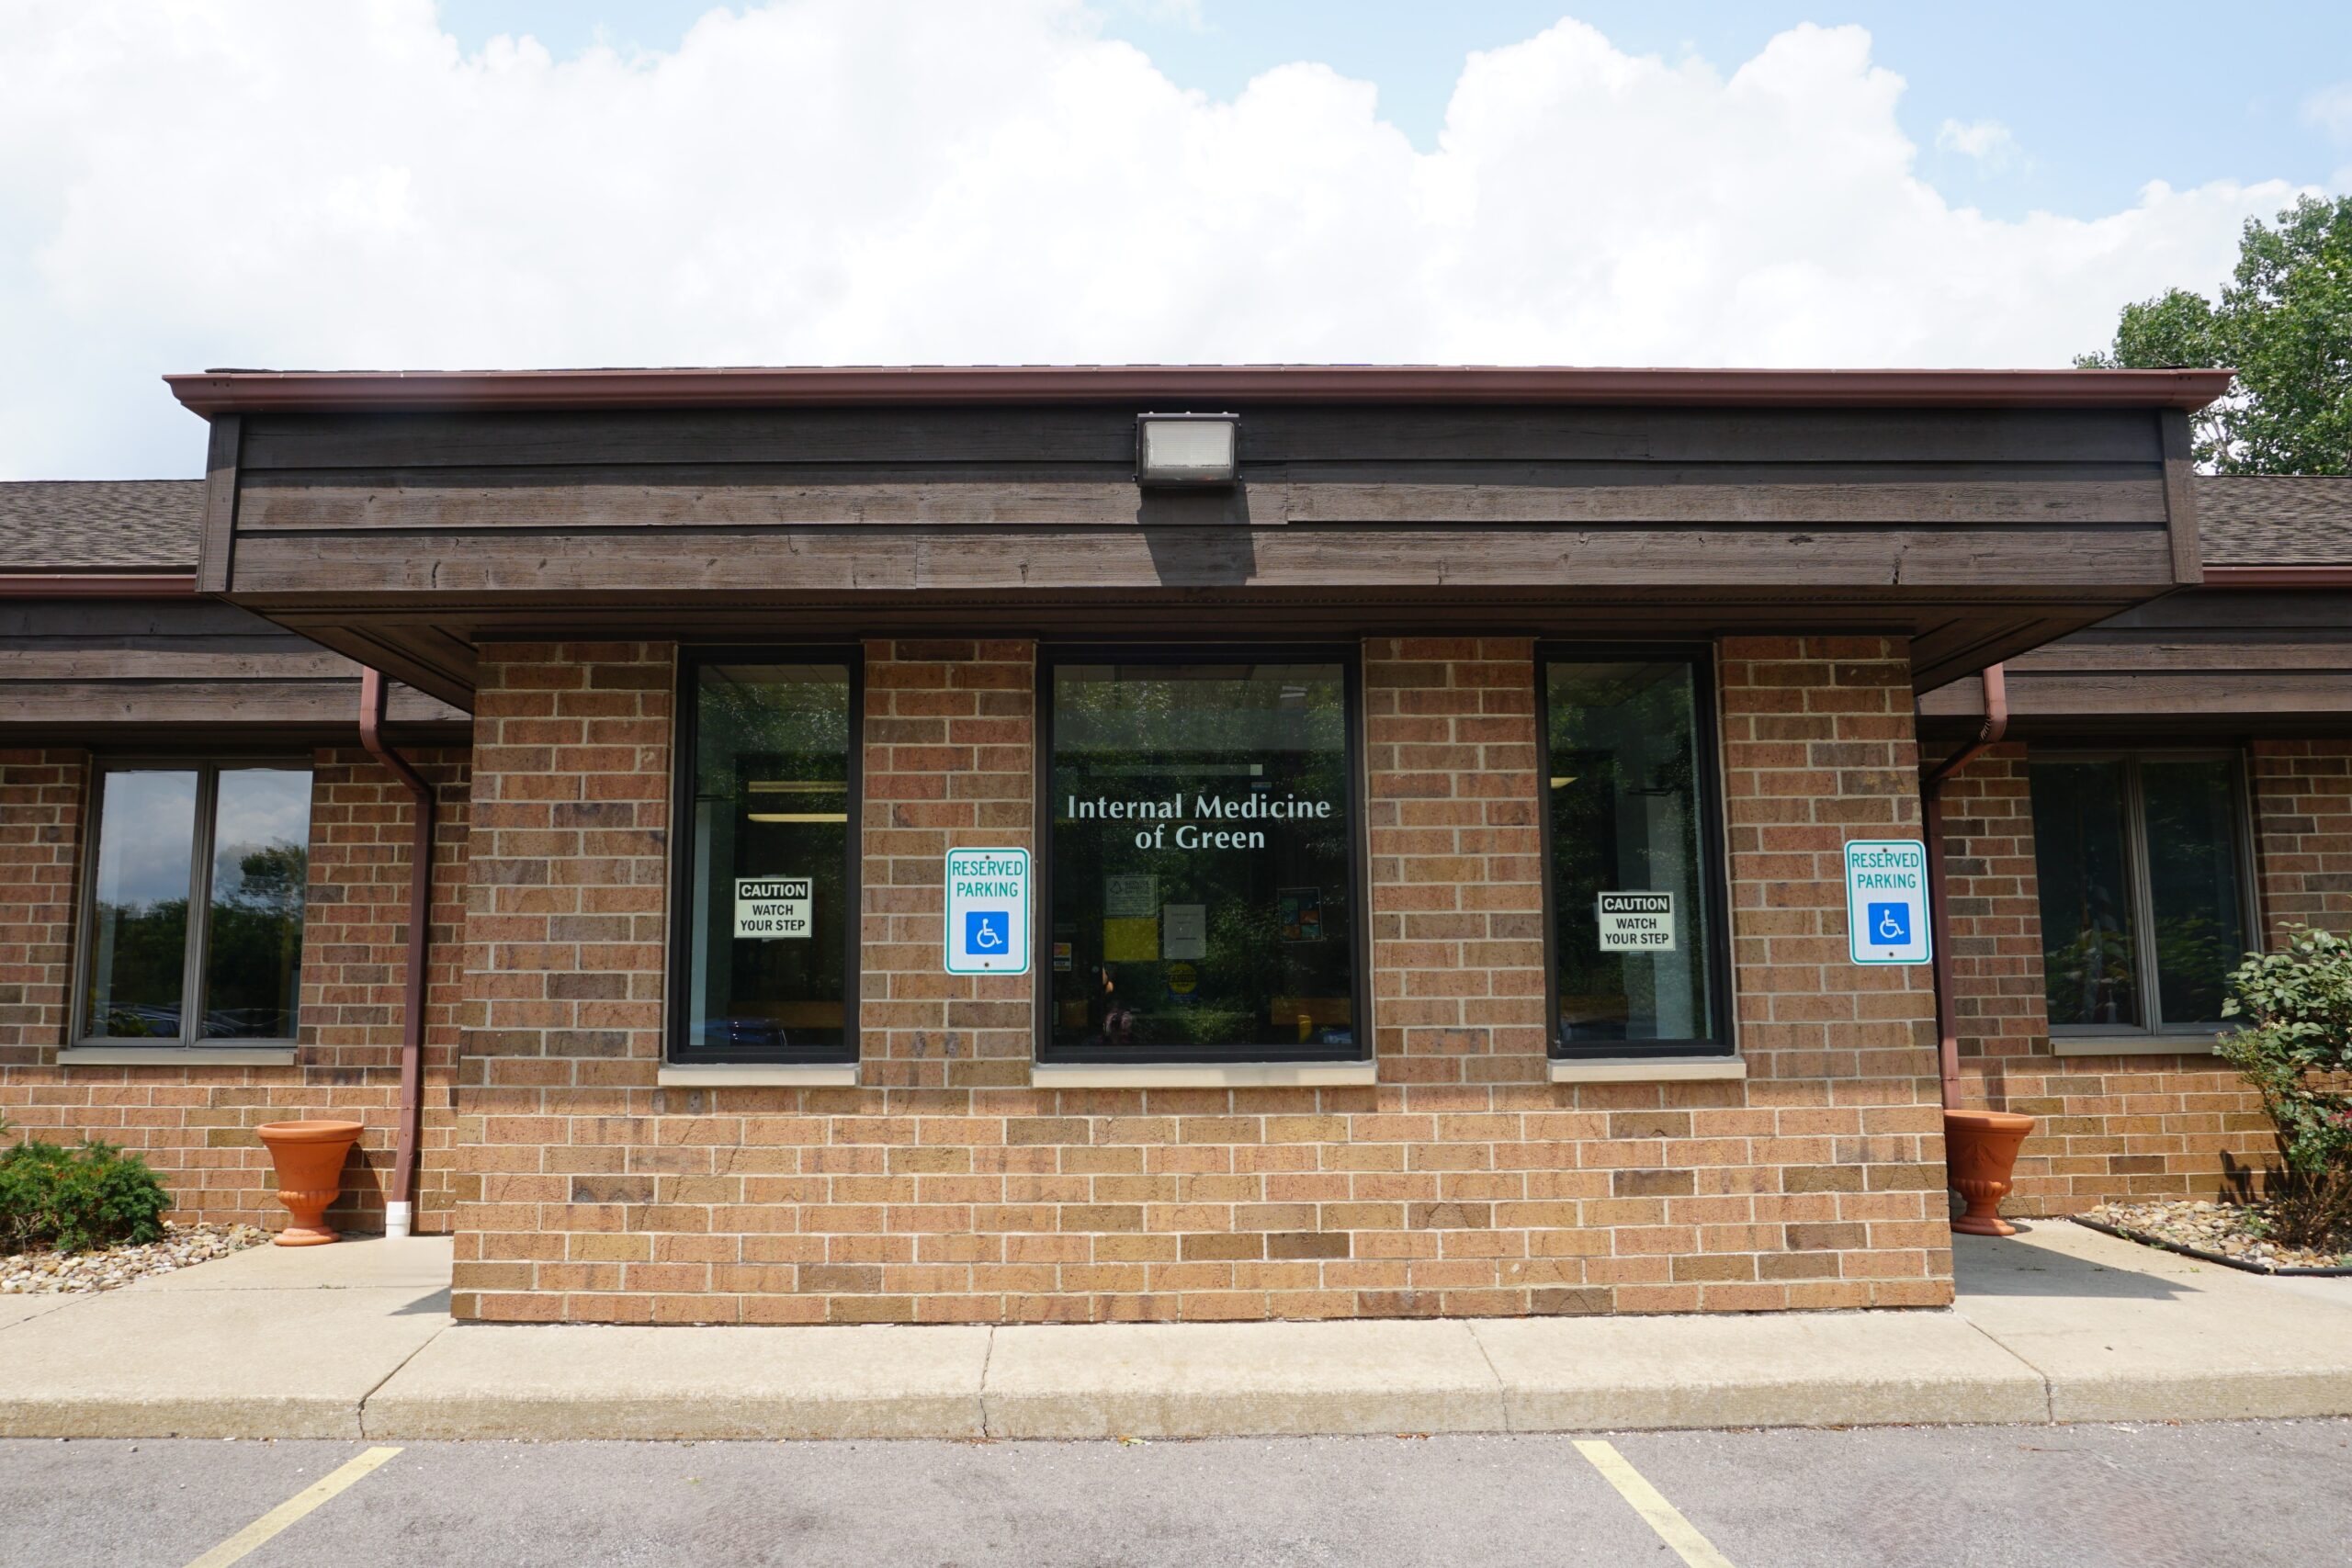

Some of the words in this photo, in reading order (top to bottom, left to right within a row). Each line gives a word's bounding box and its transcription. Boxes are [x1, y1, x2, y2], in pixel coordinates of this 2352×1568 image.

[1068, 793, 1182, 818] Internal
[1194, 793, 1331, 818] Medicine
[1135, 823, 1165, 849] of
[1175, 825, 1265, 849] Green
[1851, 852, 1919, 868] RESERVED
[952, 861, 1023, 876] RESERVED
[1857, 874, 1917, 889] PARKING
[741, 884, 806, 897] CAUTION
[956, 882, 1019, 897] PARKING
[752, 904, 794, 916] WATCH
[1603, 897, 1668, 910] CAUTION
[741, 919, 773, 931] YOUR
[775, 919, 806, 931] STEP
[1615, 918, 1657, 930] WATCH
[1605, 933, 1637, 944] YOUR
[1640, 933, 1669, 944] STEP
